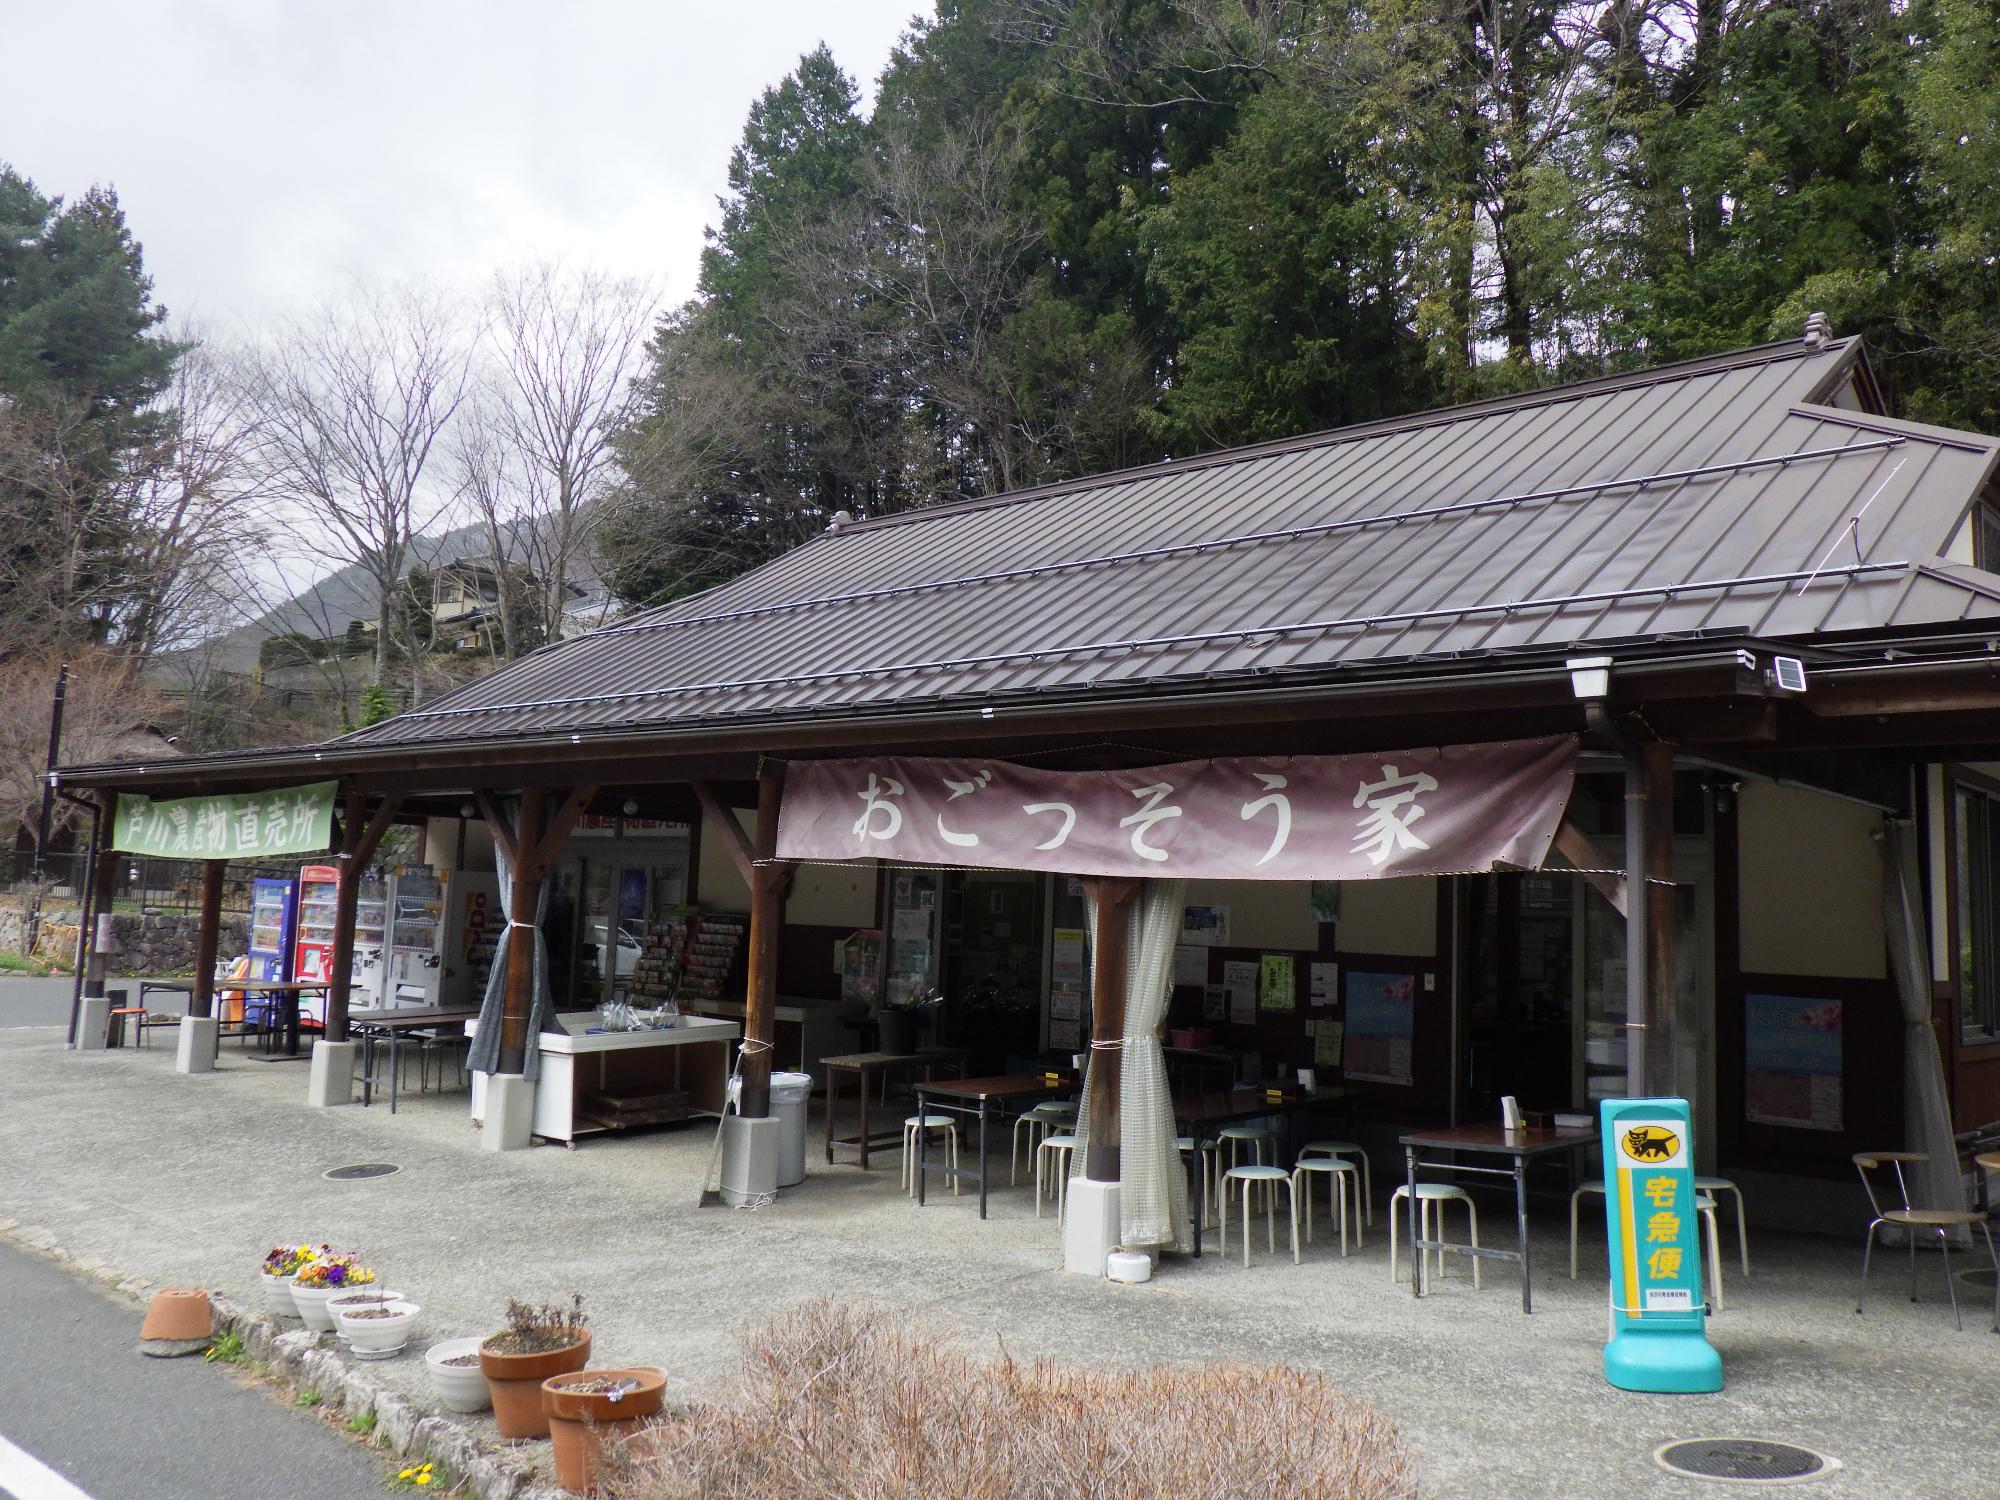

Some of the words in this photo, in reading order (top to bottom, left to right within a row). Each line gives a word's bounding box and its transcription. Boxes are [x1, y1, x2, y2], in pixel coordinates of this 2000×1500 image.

[125, 794, 319, 852] 芦川農産物直売所
[1644, 1175, 1683, 1280] 宅急便
